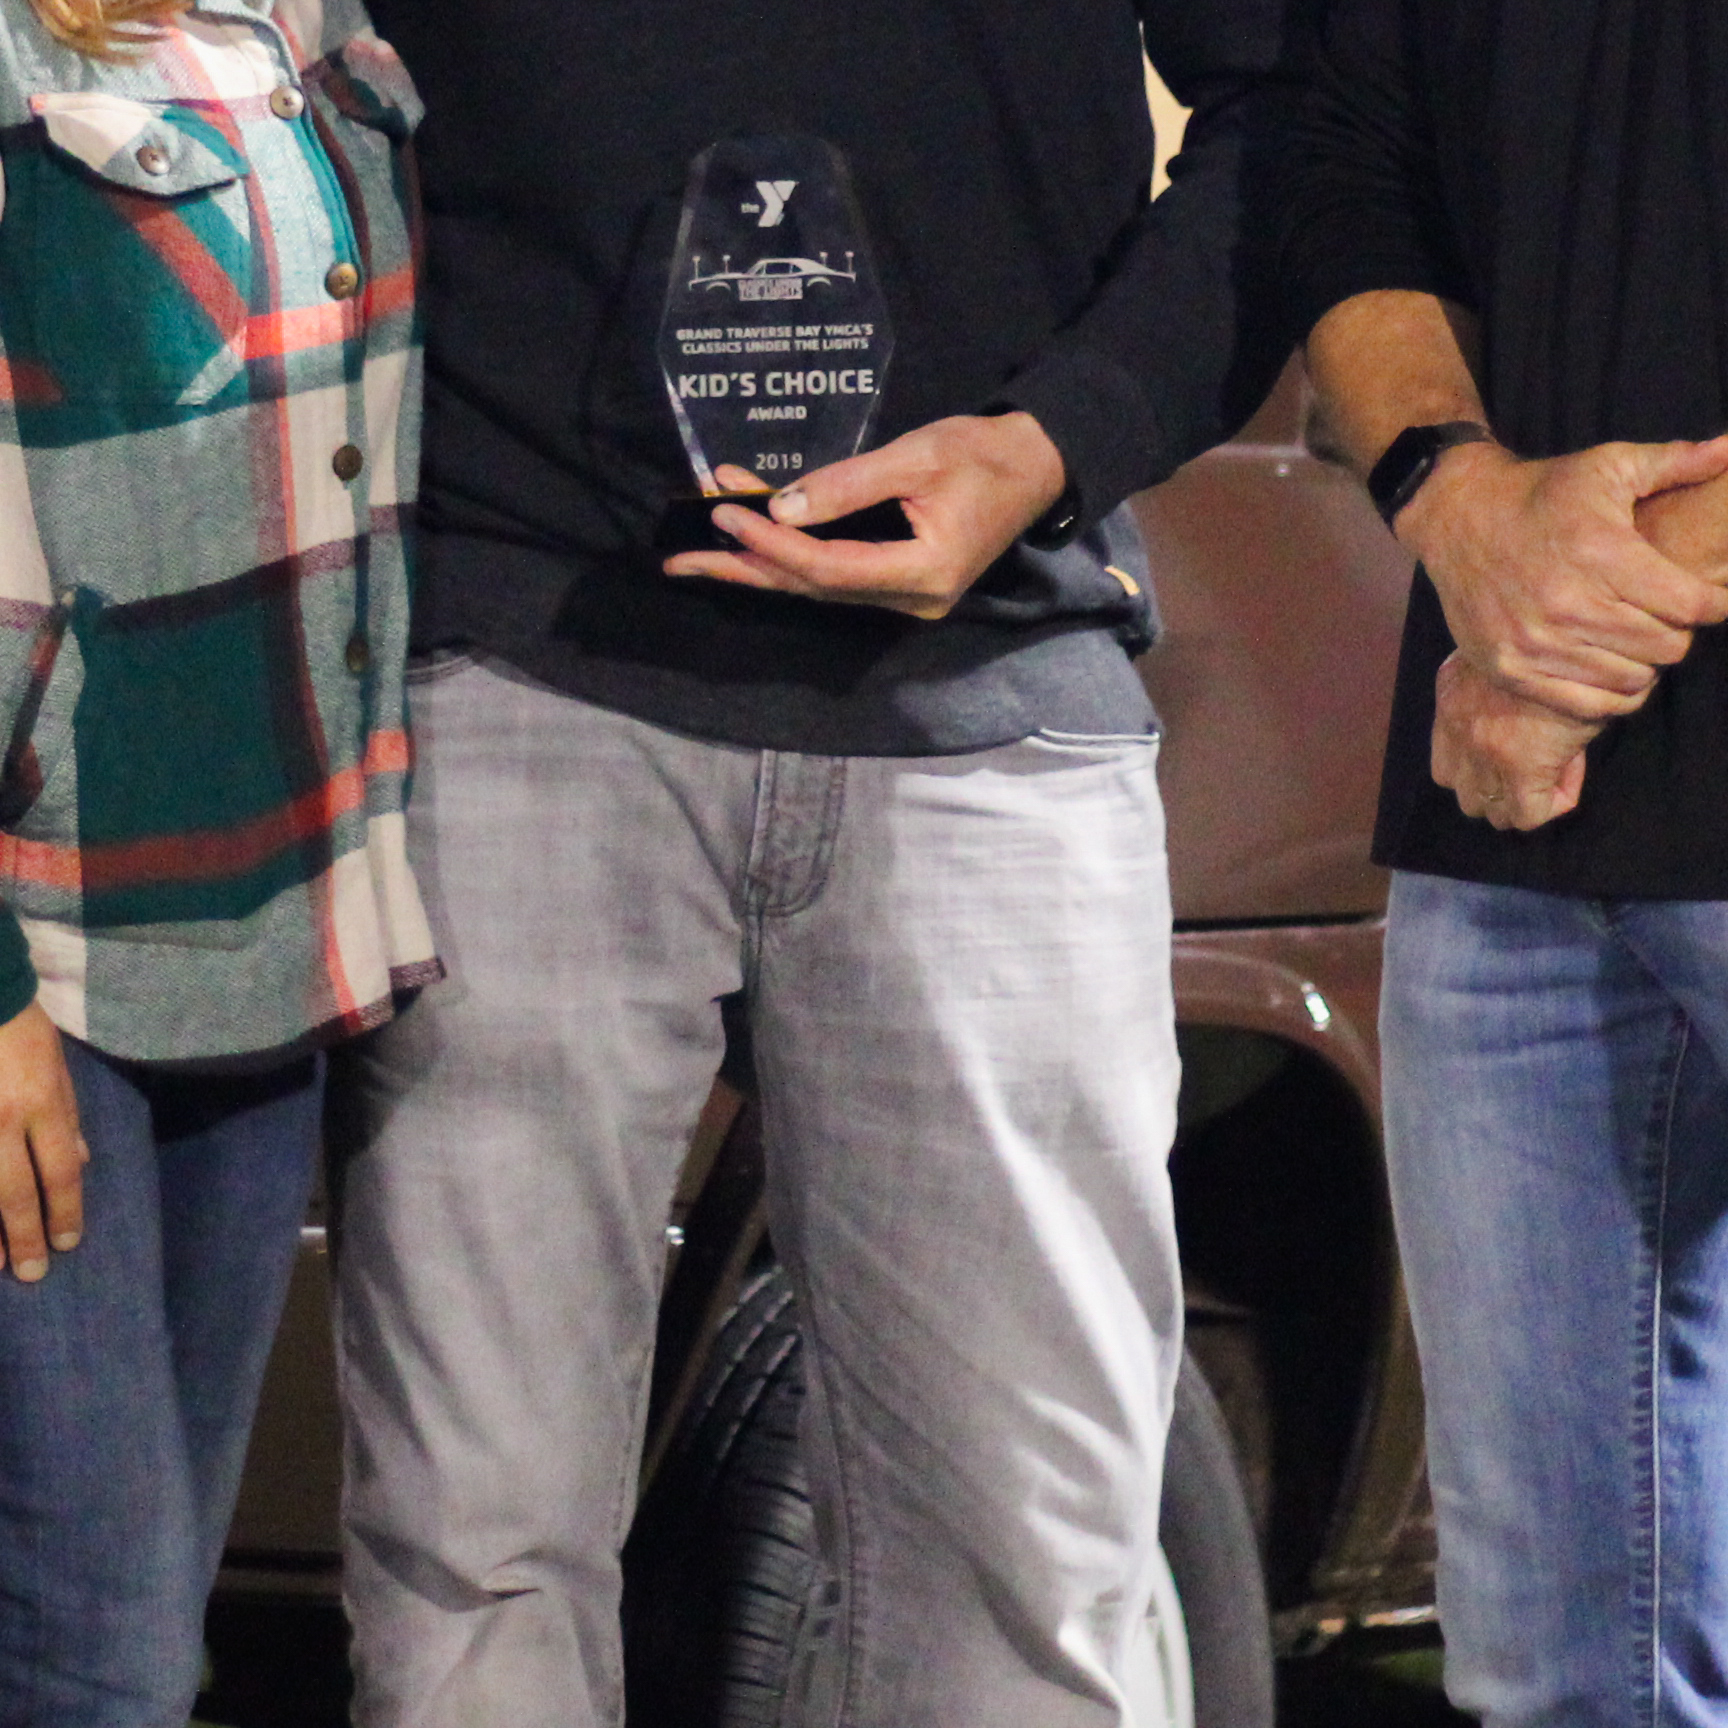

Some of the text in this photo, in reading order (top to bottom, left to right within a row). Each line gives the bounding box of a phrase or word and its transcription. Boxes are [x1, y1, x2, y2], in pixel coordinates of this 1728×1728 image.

[676, 323, 874, 341] GRAND TRAVERSE BAY YMCA'S
[682, 337, 869, 355] CLASSICS UNDER THE LIGHTS
[678, 369, 874, 399] KID'S CHOICE
[746, 405, 808, 421] AWARD
[755, 452, 803, 471] 2019
